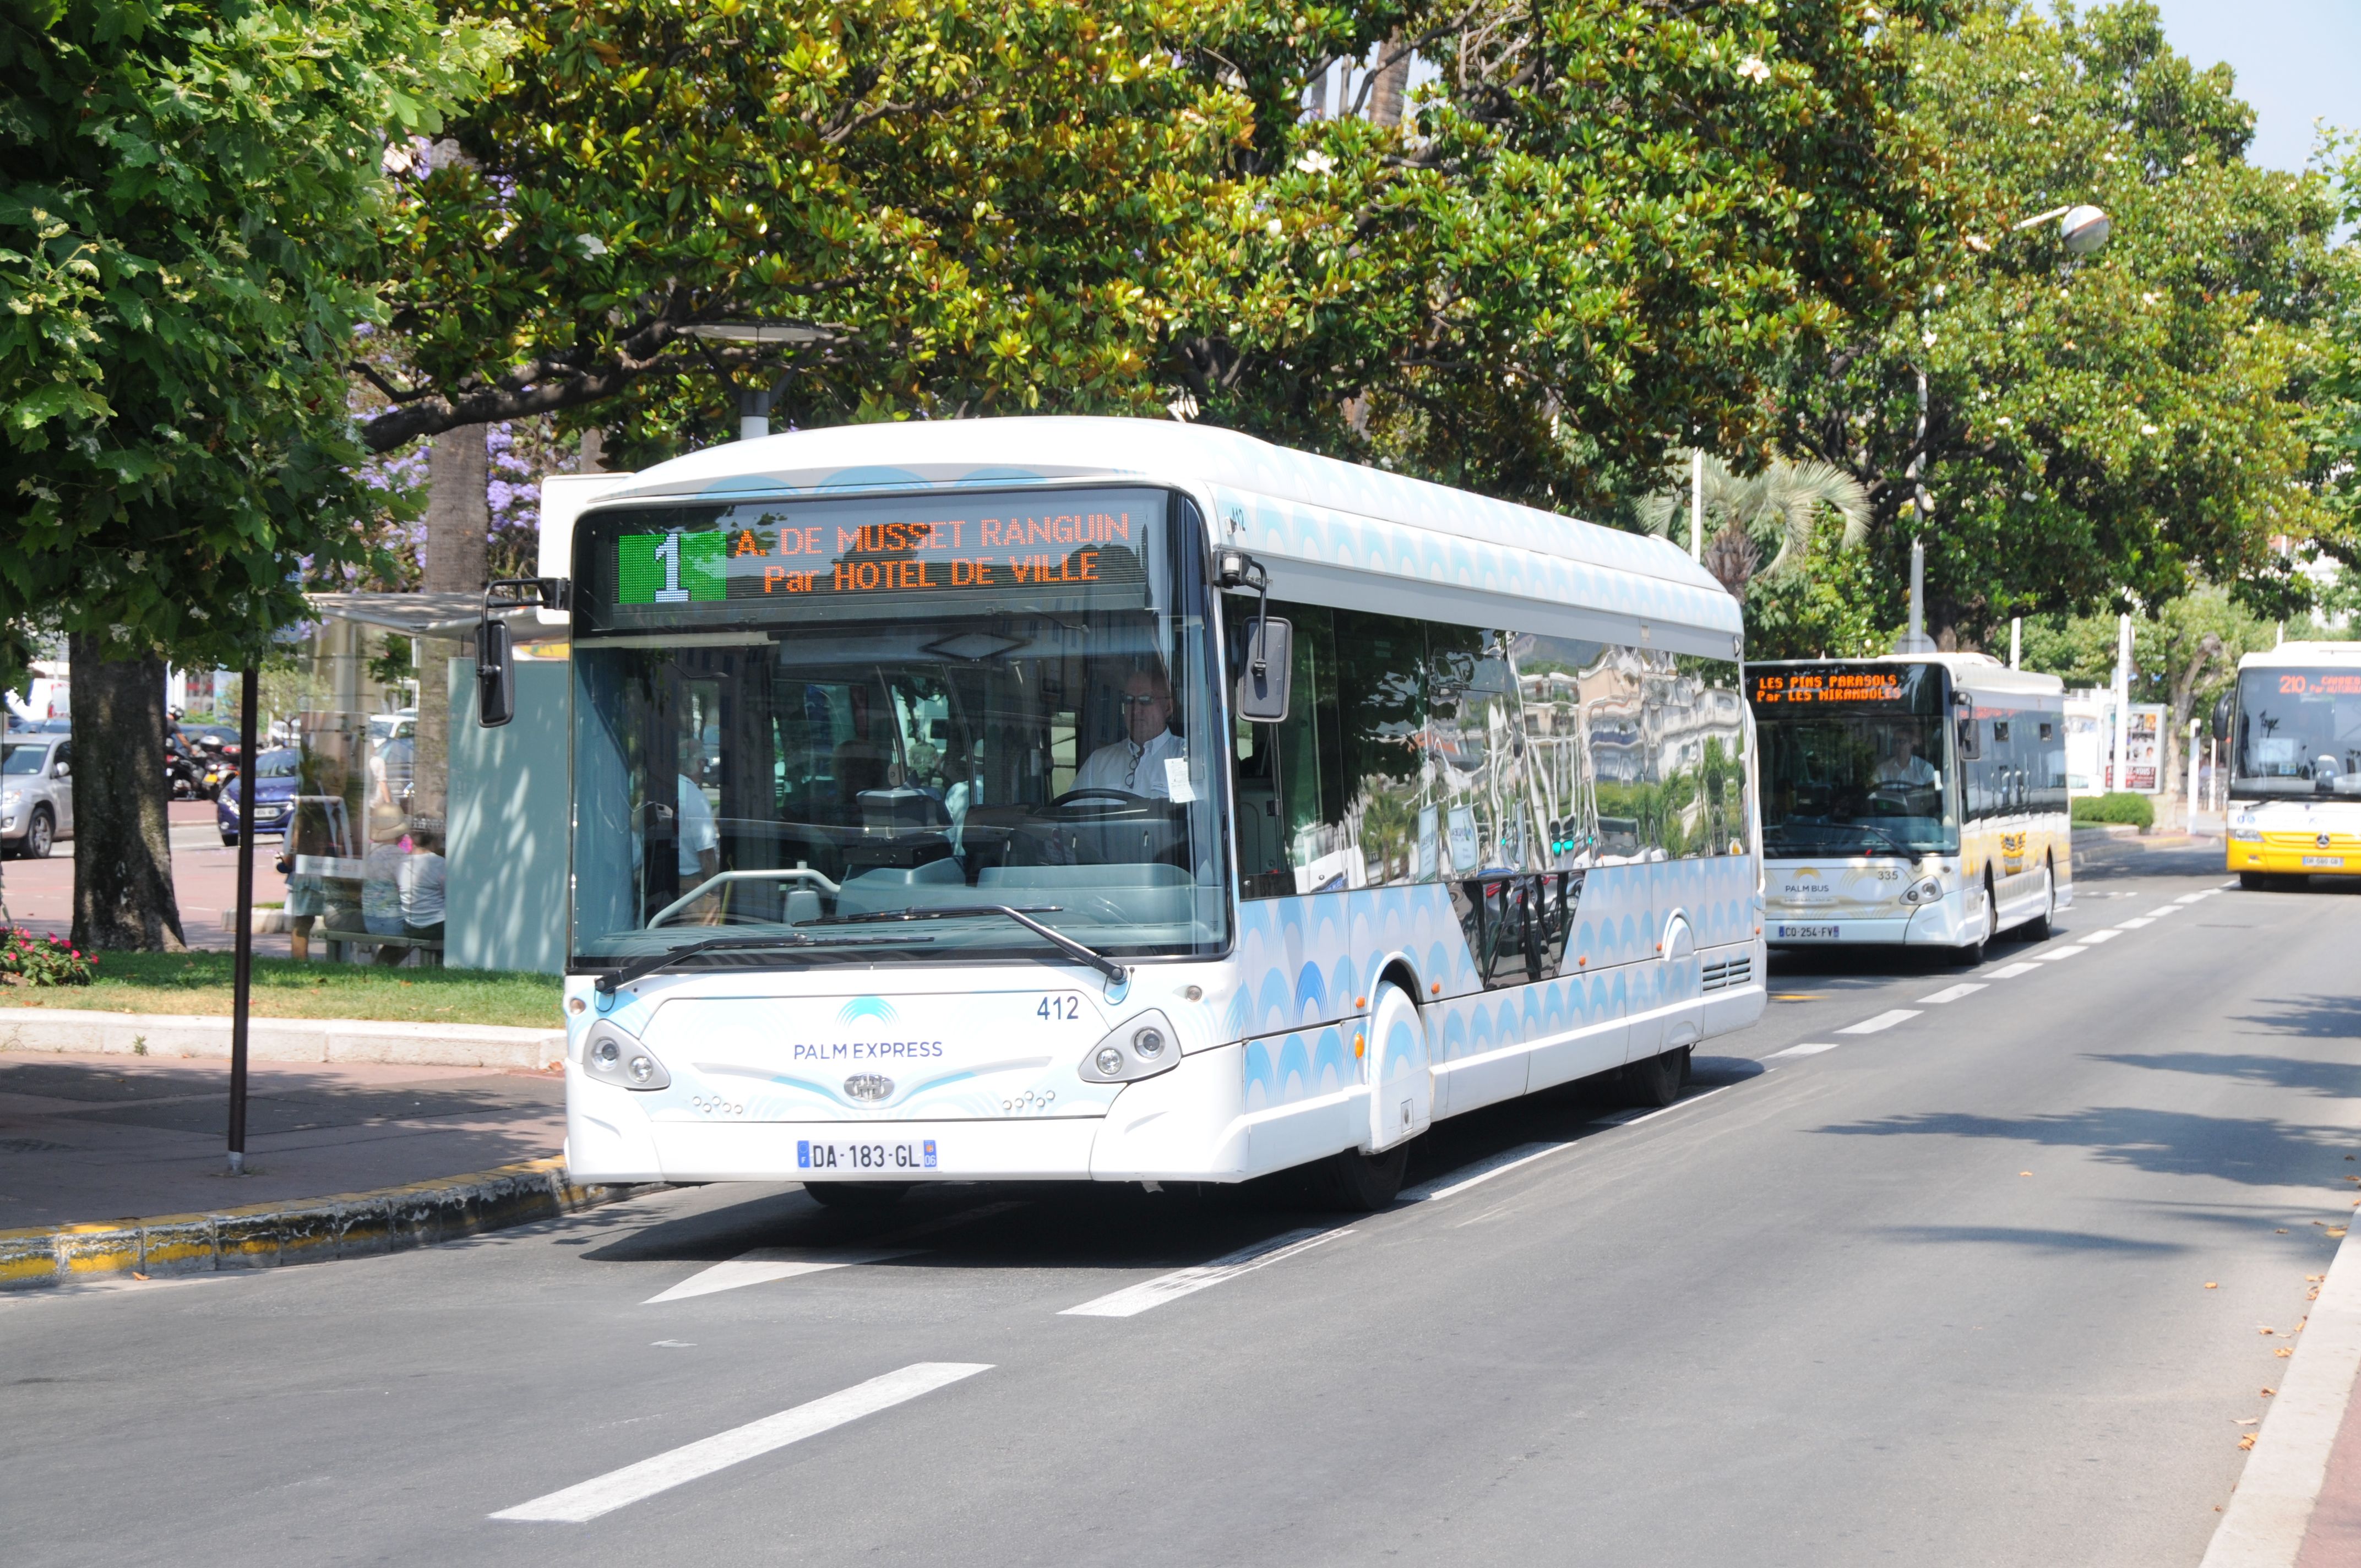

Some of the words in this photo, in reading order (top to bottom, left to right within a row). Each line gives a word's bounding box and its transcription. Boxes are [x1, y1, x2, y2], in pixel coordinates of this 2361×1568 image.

[735, 530, 767, 557] A.
[780, 527, 823, 556] DE
[837, 520, 965, 553] MUSSET
[981, 513, 1129, 547] RANGUIN
[655, 533, 689, 603] 1
[764, 565, 819, 593] Par
[834, 560, 936, 590] HOTEL
[951, 557, 994, 585] DE
[1009, 552, 1100, 583] VILLE
[1759, 677, 1783, 689] LES
[1790, 676, 1823, 688] PINS
[1829, 674, 1897, 688] PARASOLS
[2280, 675, 2306, 694] 210
[1756, 690, 1781, 703] Par
[1788, 689, 1812, 701] LES
[1819, 687, 1902, 701] MIRANDOLES
[1878, 871, 1898, 880] 335
[1037, 996, 1079, 1020] 412
[794, 1043, 847, 1060] PALM
[853, 1041, 943, 1059] EXPRESS
[813, 1145, 921, 1168] DA-183-GL
[924, 1155, 936, 1166] 06
